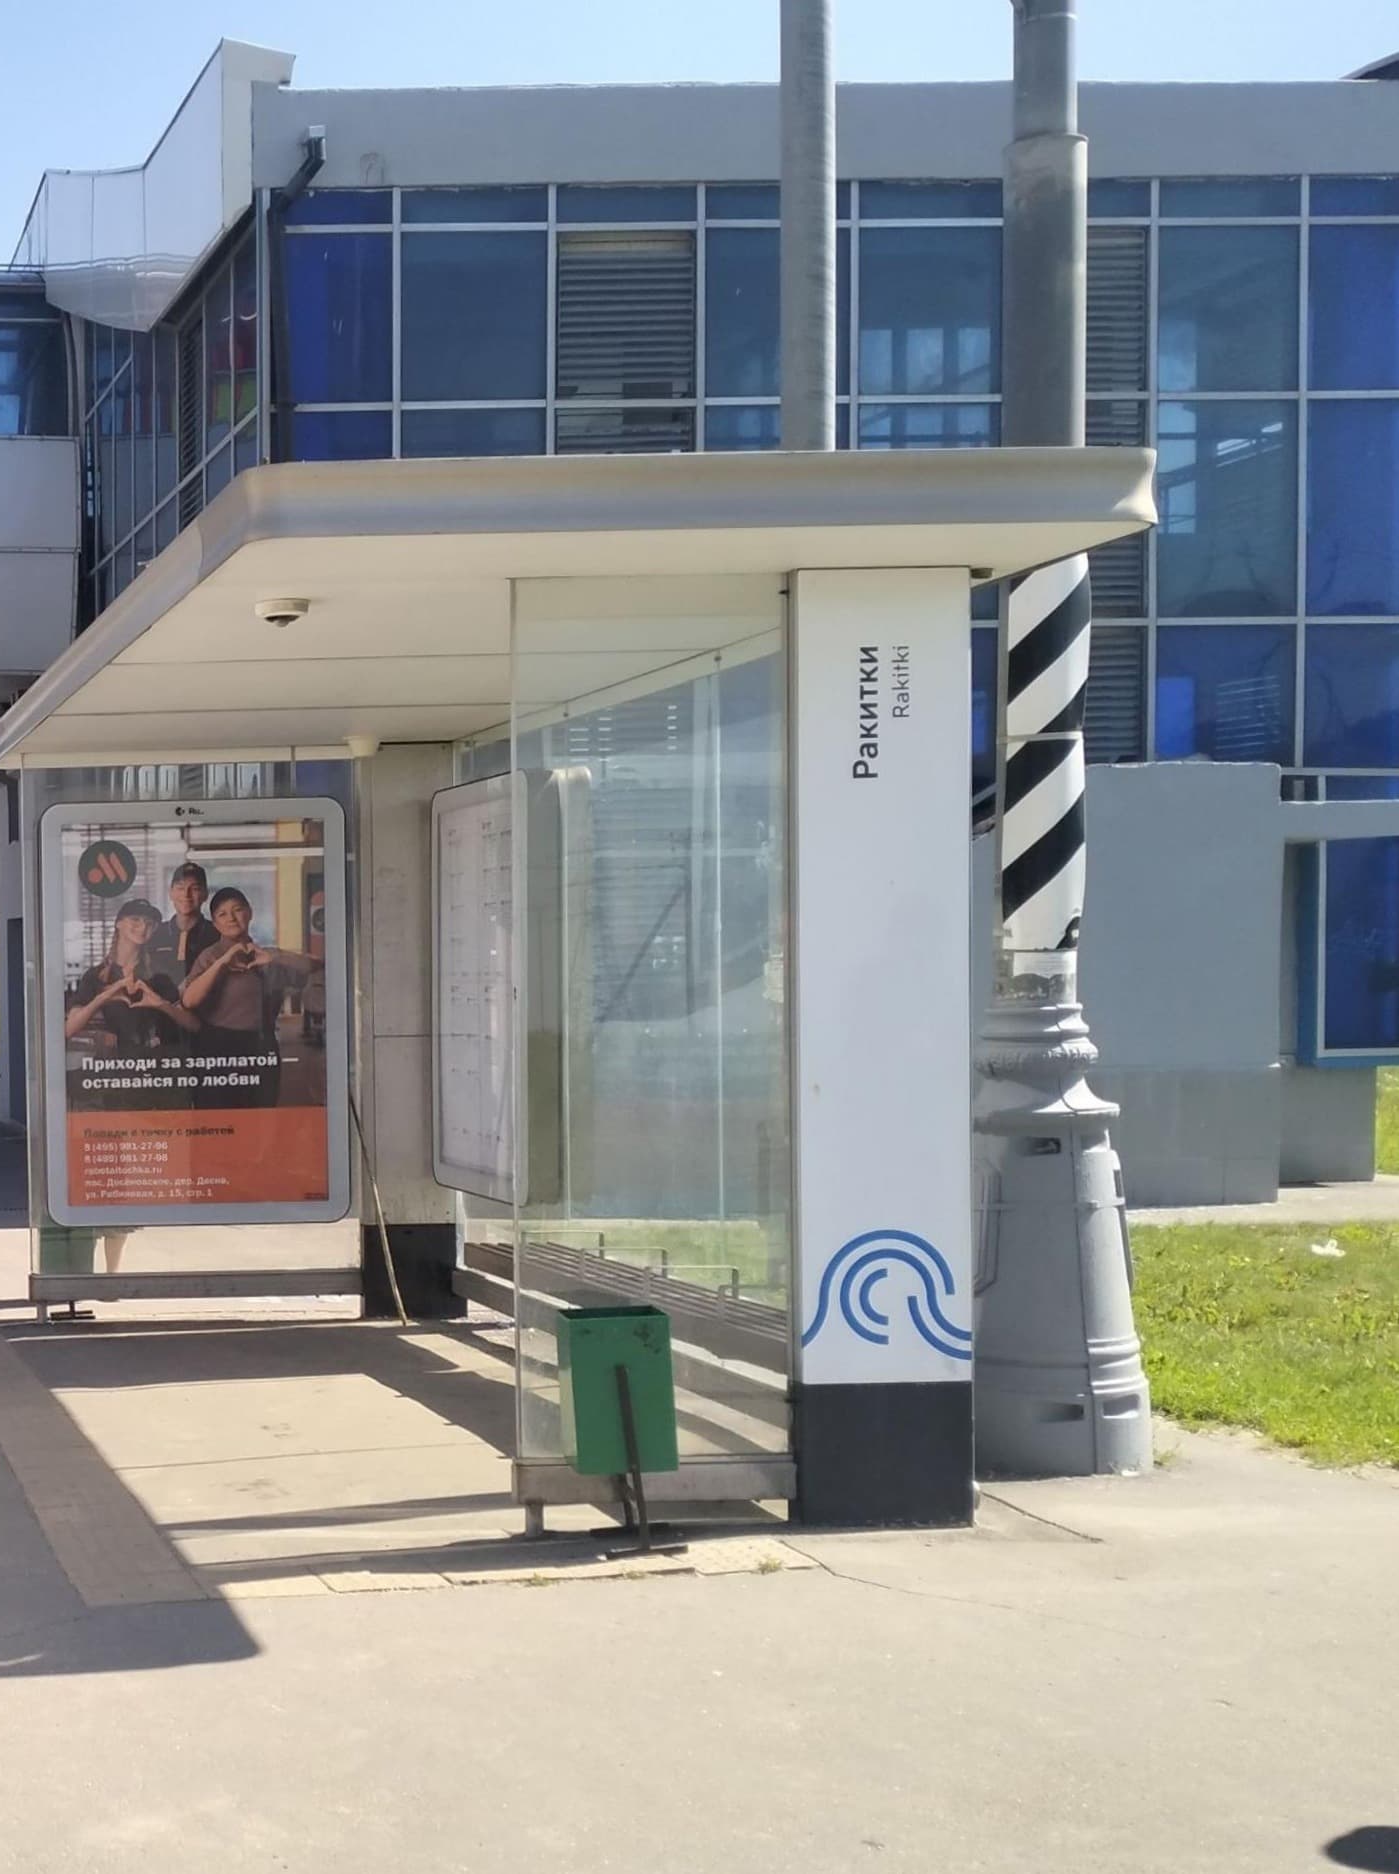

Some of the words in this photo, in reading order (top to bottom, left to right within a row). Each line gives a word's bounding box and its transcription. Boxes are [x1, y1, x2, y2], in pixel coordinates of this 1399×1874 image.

[891, 645, 910, 718] Rakitki
[852, 646, 879, 779] Ракитки
[81, 1056, 157, 1072] Приходи
[160, 1057, 182, 1070] за
[185, 1052, 278, 1070] зарплатой
[81, 1073, 173, 1089] оставайся
[177, 1076, 199, 1088] по
[201, 1072, 261, 1087] любви
